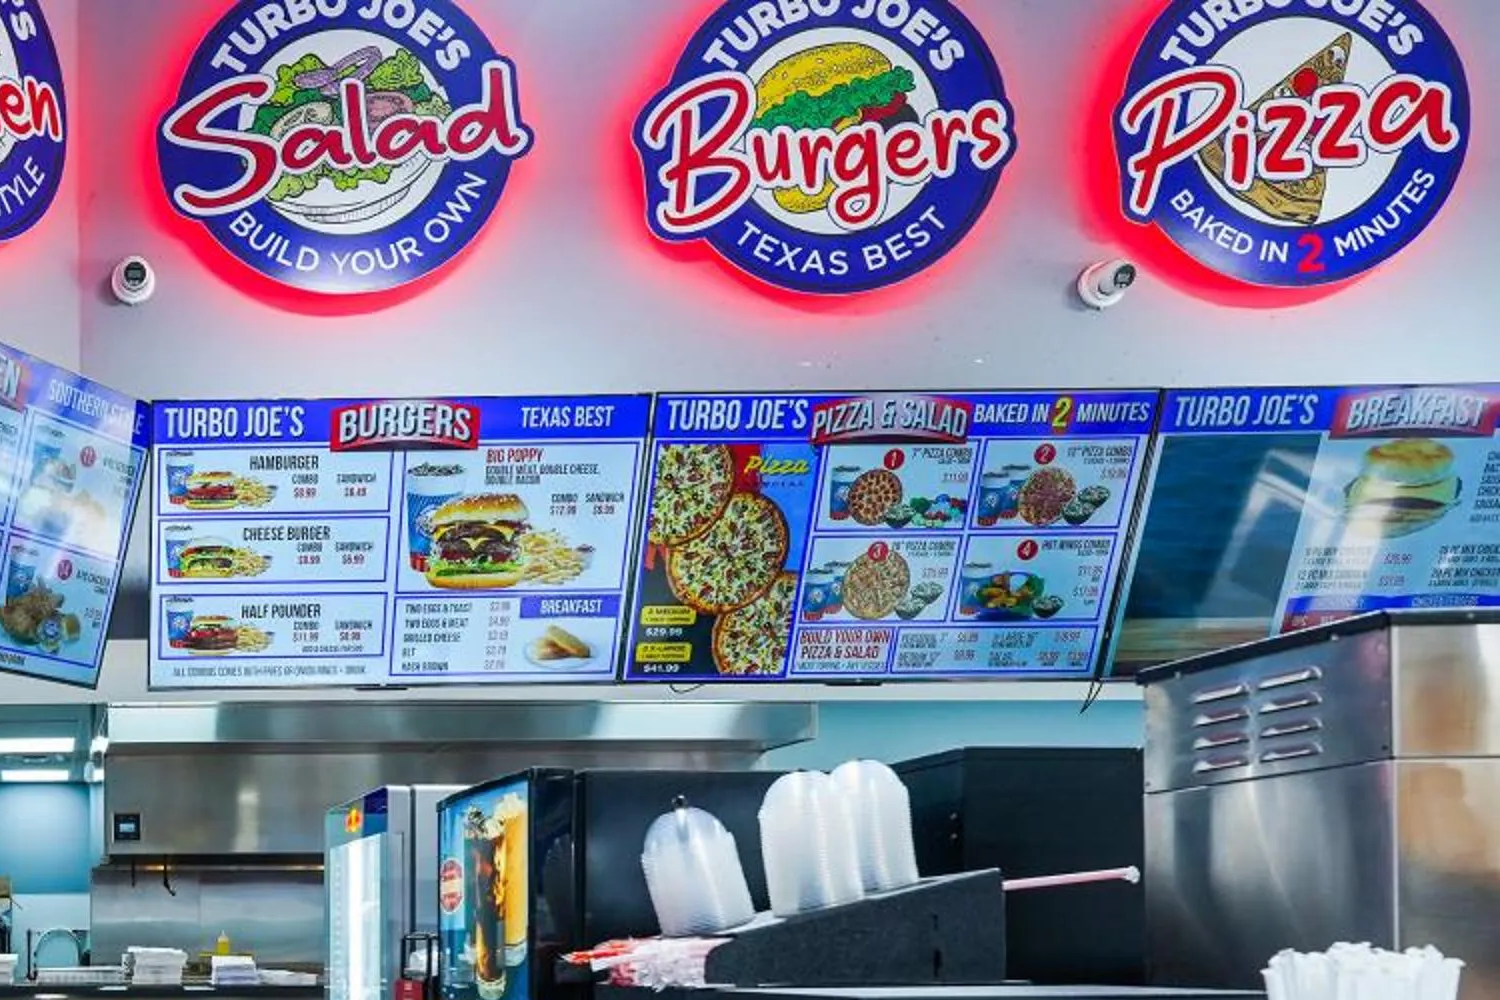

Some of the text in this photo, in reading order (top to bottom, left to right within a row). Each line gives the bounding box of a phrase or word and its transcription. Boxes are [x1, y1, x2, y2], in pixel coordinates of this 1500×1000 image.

[211, 0, 472, 73] TURBO JOE'S
[703, 0, 966, 72] TURBO JOE'S
[166, 62, 528, 213] Salad
[647, 74, 1007, 230] Burgers
[1123, 68, 1457, 212] Pizza
[229, 171, 488, 275] BUILD YOUR OWN
[736, 206, 947, 277] TEXAS BEST
[1171, 168, 1436, 274] BAKED IN 2 MINUTES
[164, 402, 615, 444] TURBO JOE'S BURGERS TEXAS BEST
[668, 396, 1150, 440] TURBO JOE'S PIZZA & SALAD BAKED IN 2 MINUTES
[1175, 389, 1490, 430] TURBO JOE'S BREAKFAST
[249, 455, 320, 471] HAMBURGER
[486, 448, 505, 463] BIG
[744, 454, 810, 475] Pizza
[242, 525, 331, 541] CHEESE BURGER
[241, 603, 321, 619] HALF POUNDER
[539, 598, 604, 615] BREAKFAST
[843, 645, 879, 659] SALAD
